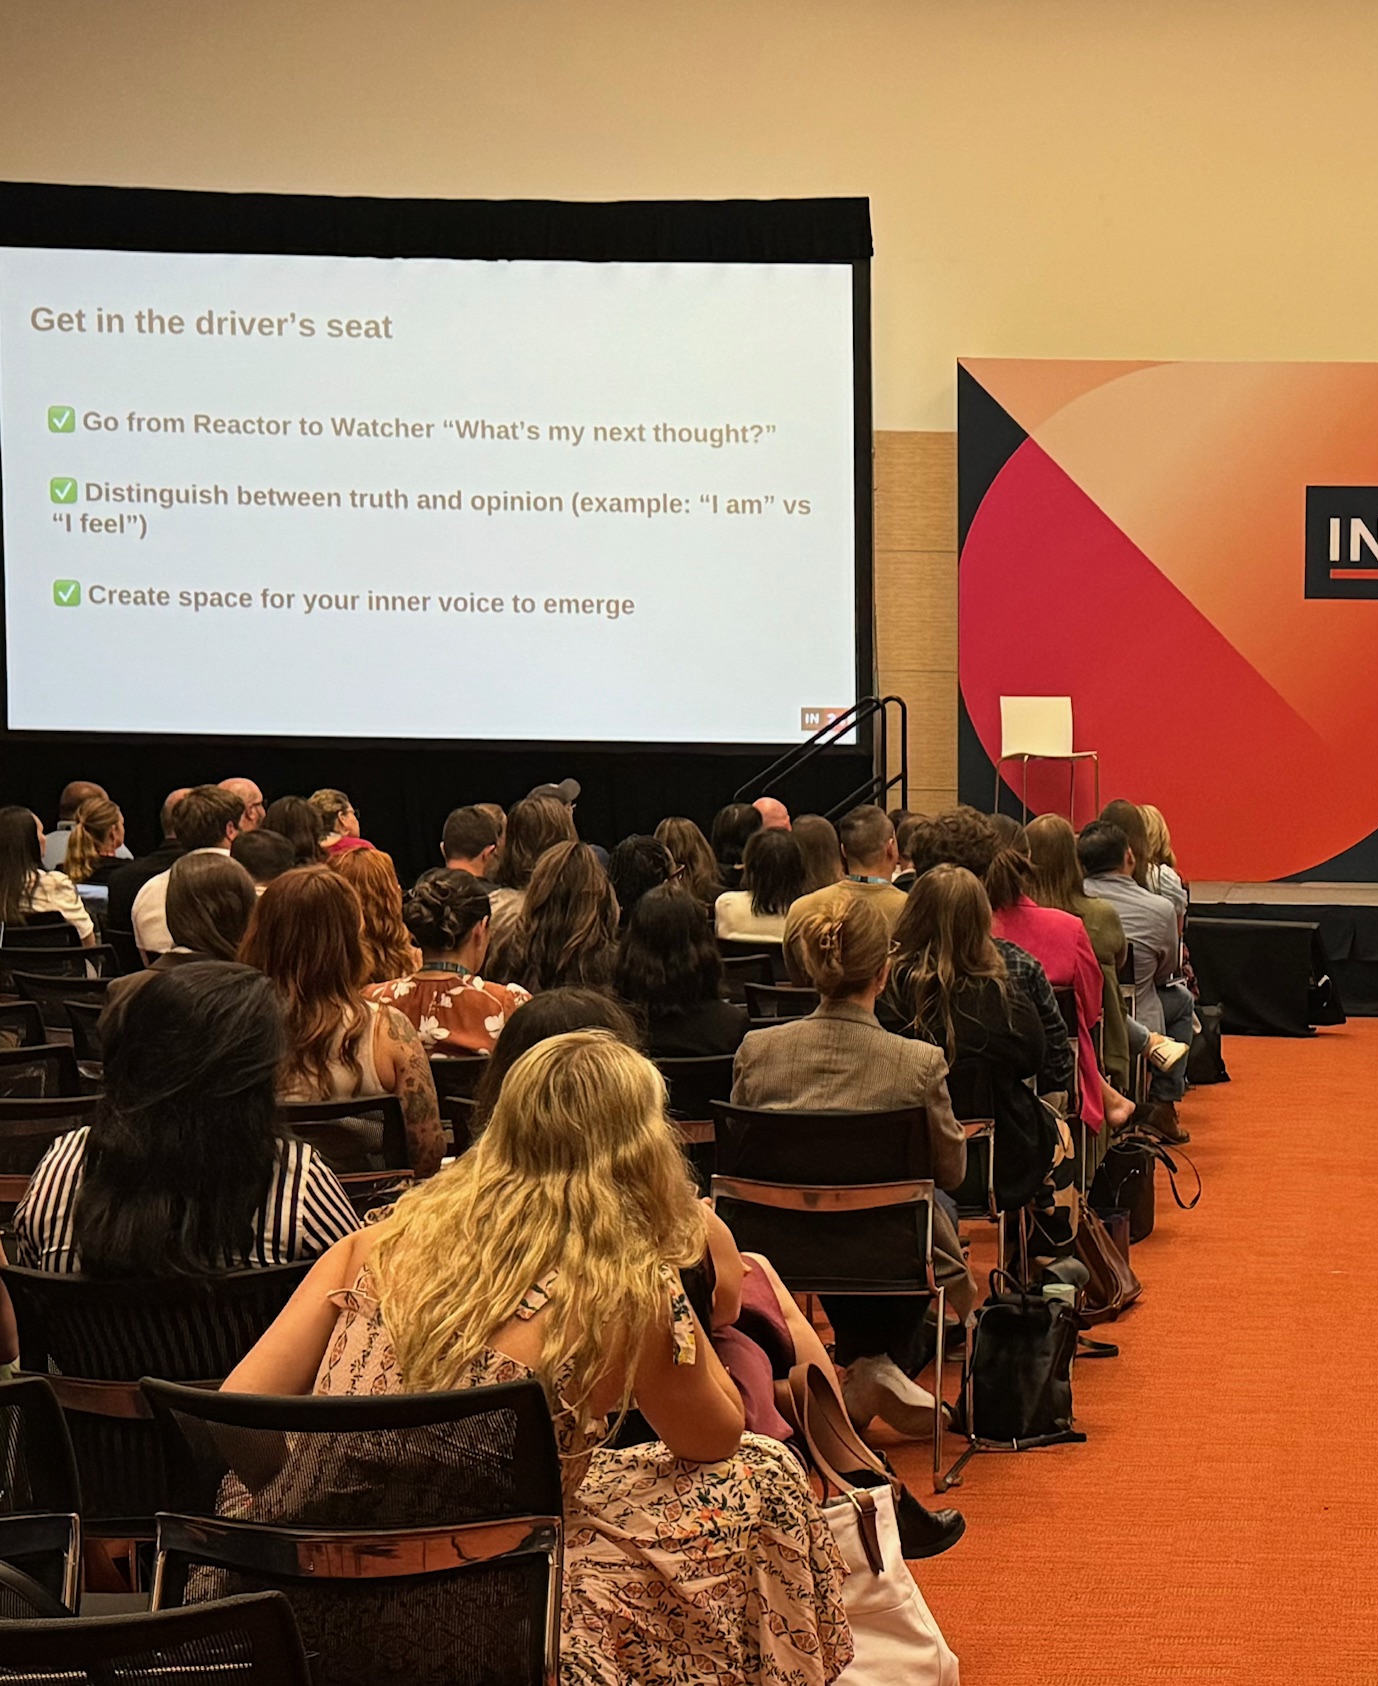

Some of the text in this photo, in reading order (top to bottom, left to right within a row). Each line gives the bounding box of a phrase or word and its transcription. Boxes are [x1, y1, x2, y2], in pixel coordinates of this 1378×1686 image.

[30, 306, 394, 340] Get in the driver’s seat
[82, 410, 776, 449] Go from Reactor to Watcher “What’s my next thought?”
[85, 481, 811, 519] Distinguish between truth and opinion (example: “I am” vs
[52, 512, 148, 541] “I feel”)
[88, 584, 635, 620] Create space for your inner voice to emerge
[804, 712, 821, 725] IN
